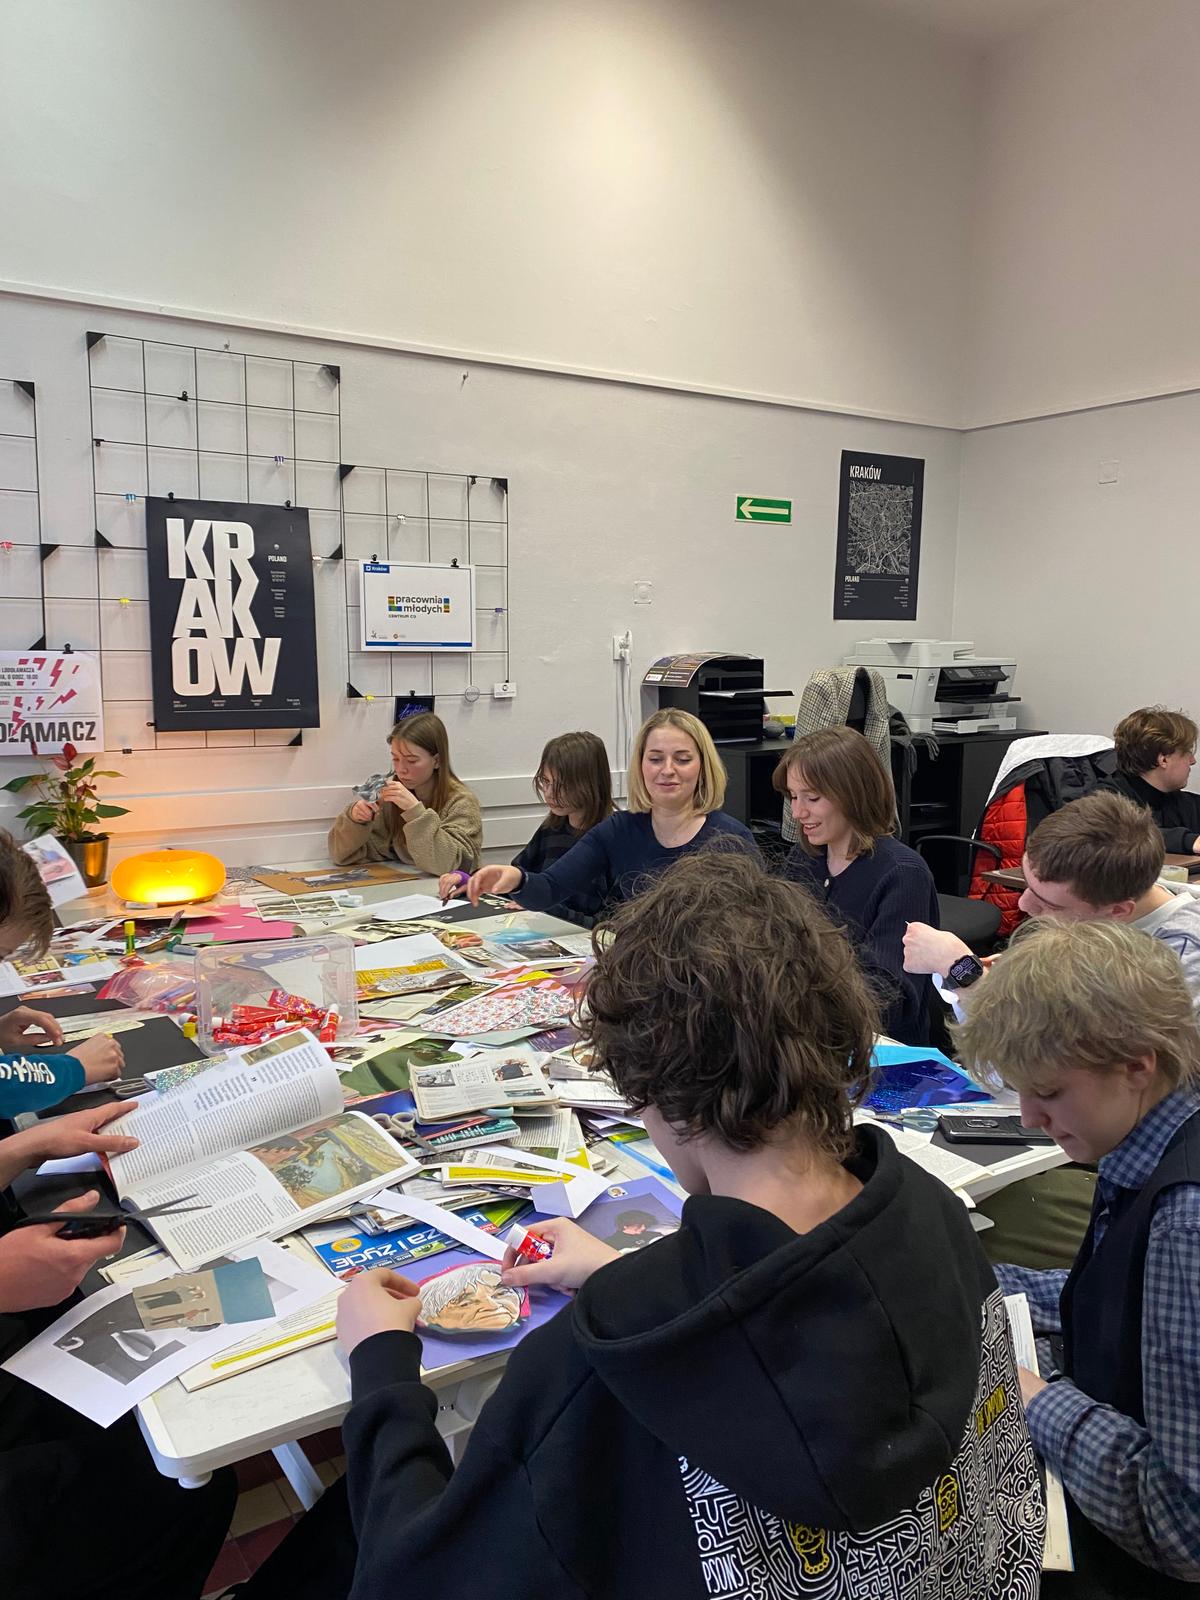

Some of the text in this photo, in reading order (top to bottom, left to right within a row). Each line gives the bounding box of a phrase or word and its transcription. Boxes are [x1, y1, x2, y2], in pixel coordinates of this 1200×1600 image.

[849, 465, 882, 480] KRAKÓW
[267, 555, 287, 563] POLAND
[844, 575, 860, 583] POLAND
[395, 595, 442, 604] pracownia
[403, 604, 443, 615] młodych
